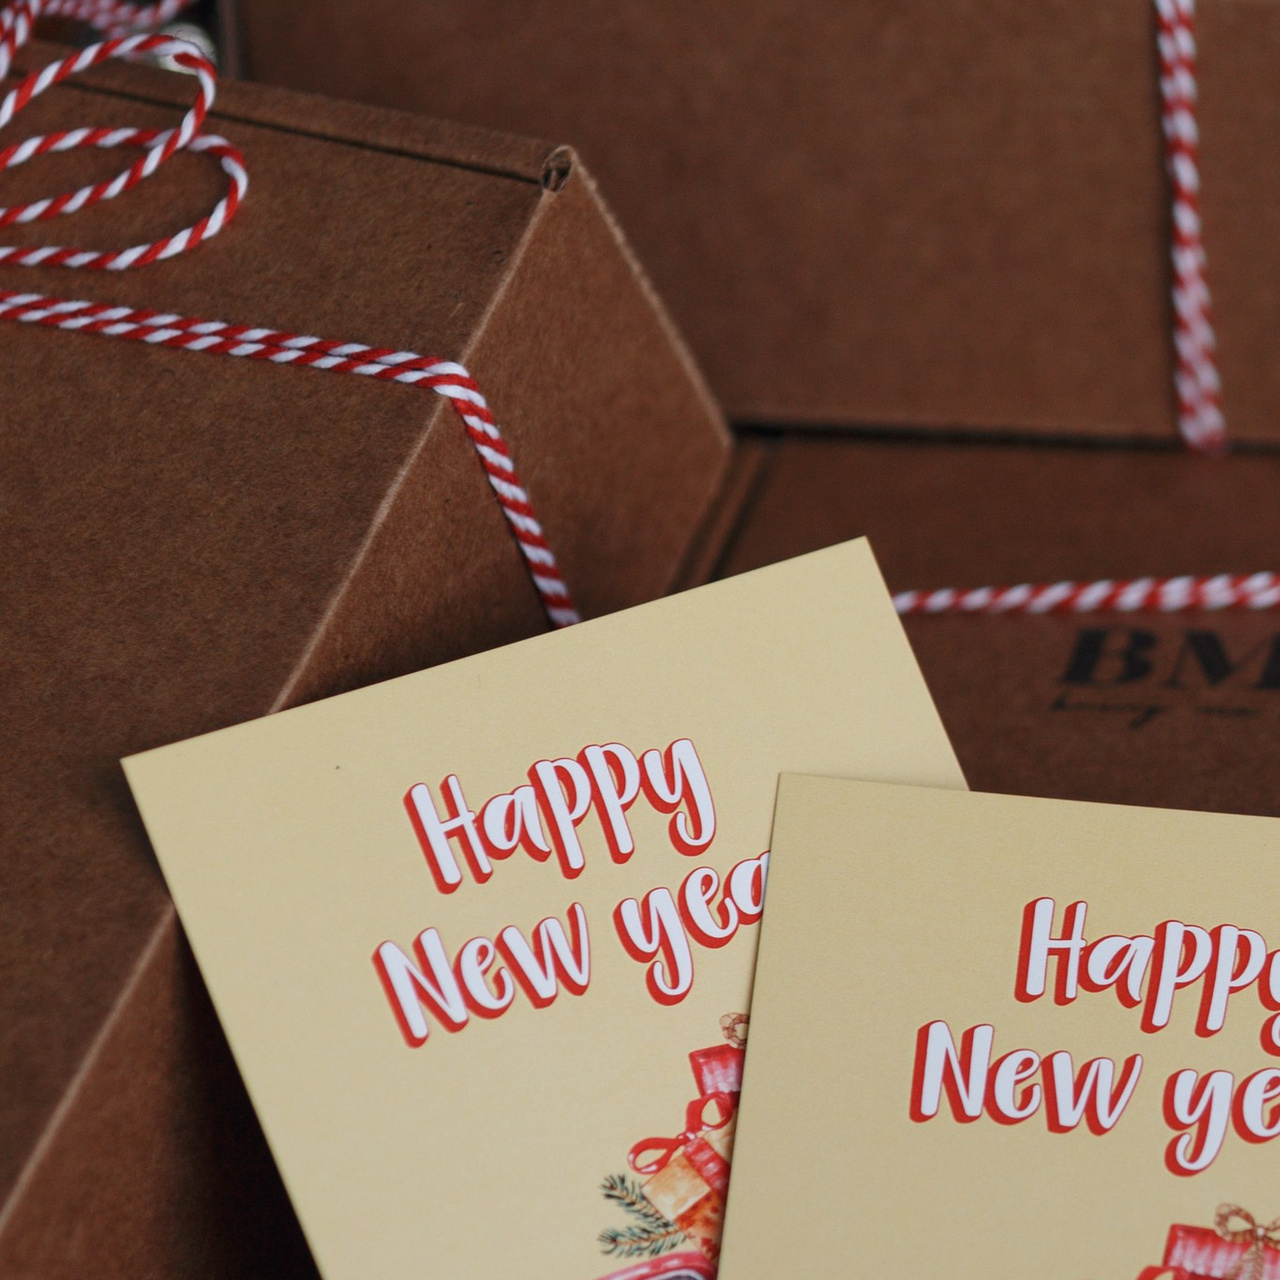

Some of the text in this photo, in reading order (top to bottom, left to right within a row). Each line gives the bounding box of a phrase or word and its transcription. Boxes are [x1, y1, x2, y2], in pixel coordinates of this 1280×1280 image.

[403, 738, 716, 894] Happy
[371, 902, 590, 1048] New
[909, 1020, 1143, 1136] New
